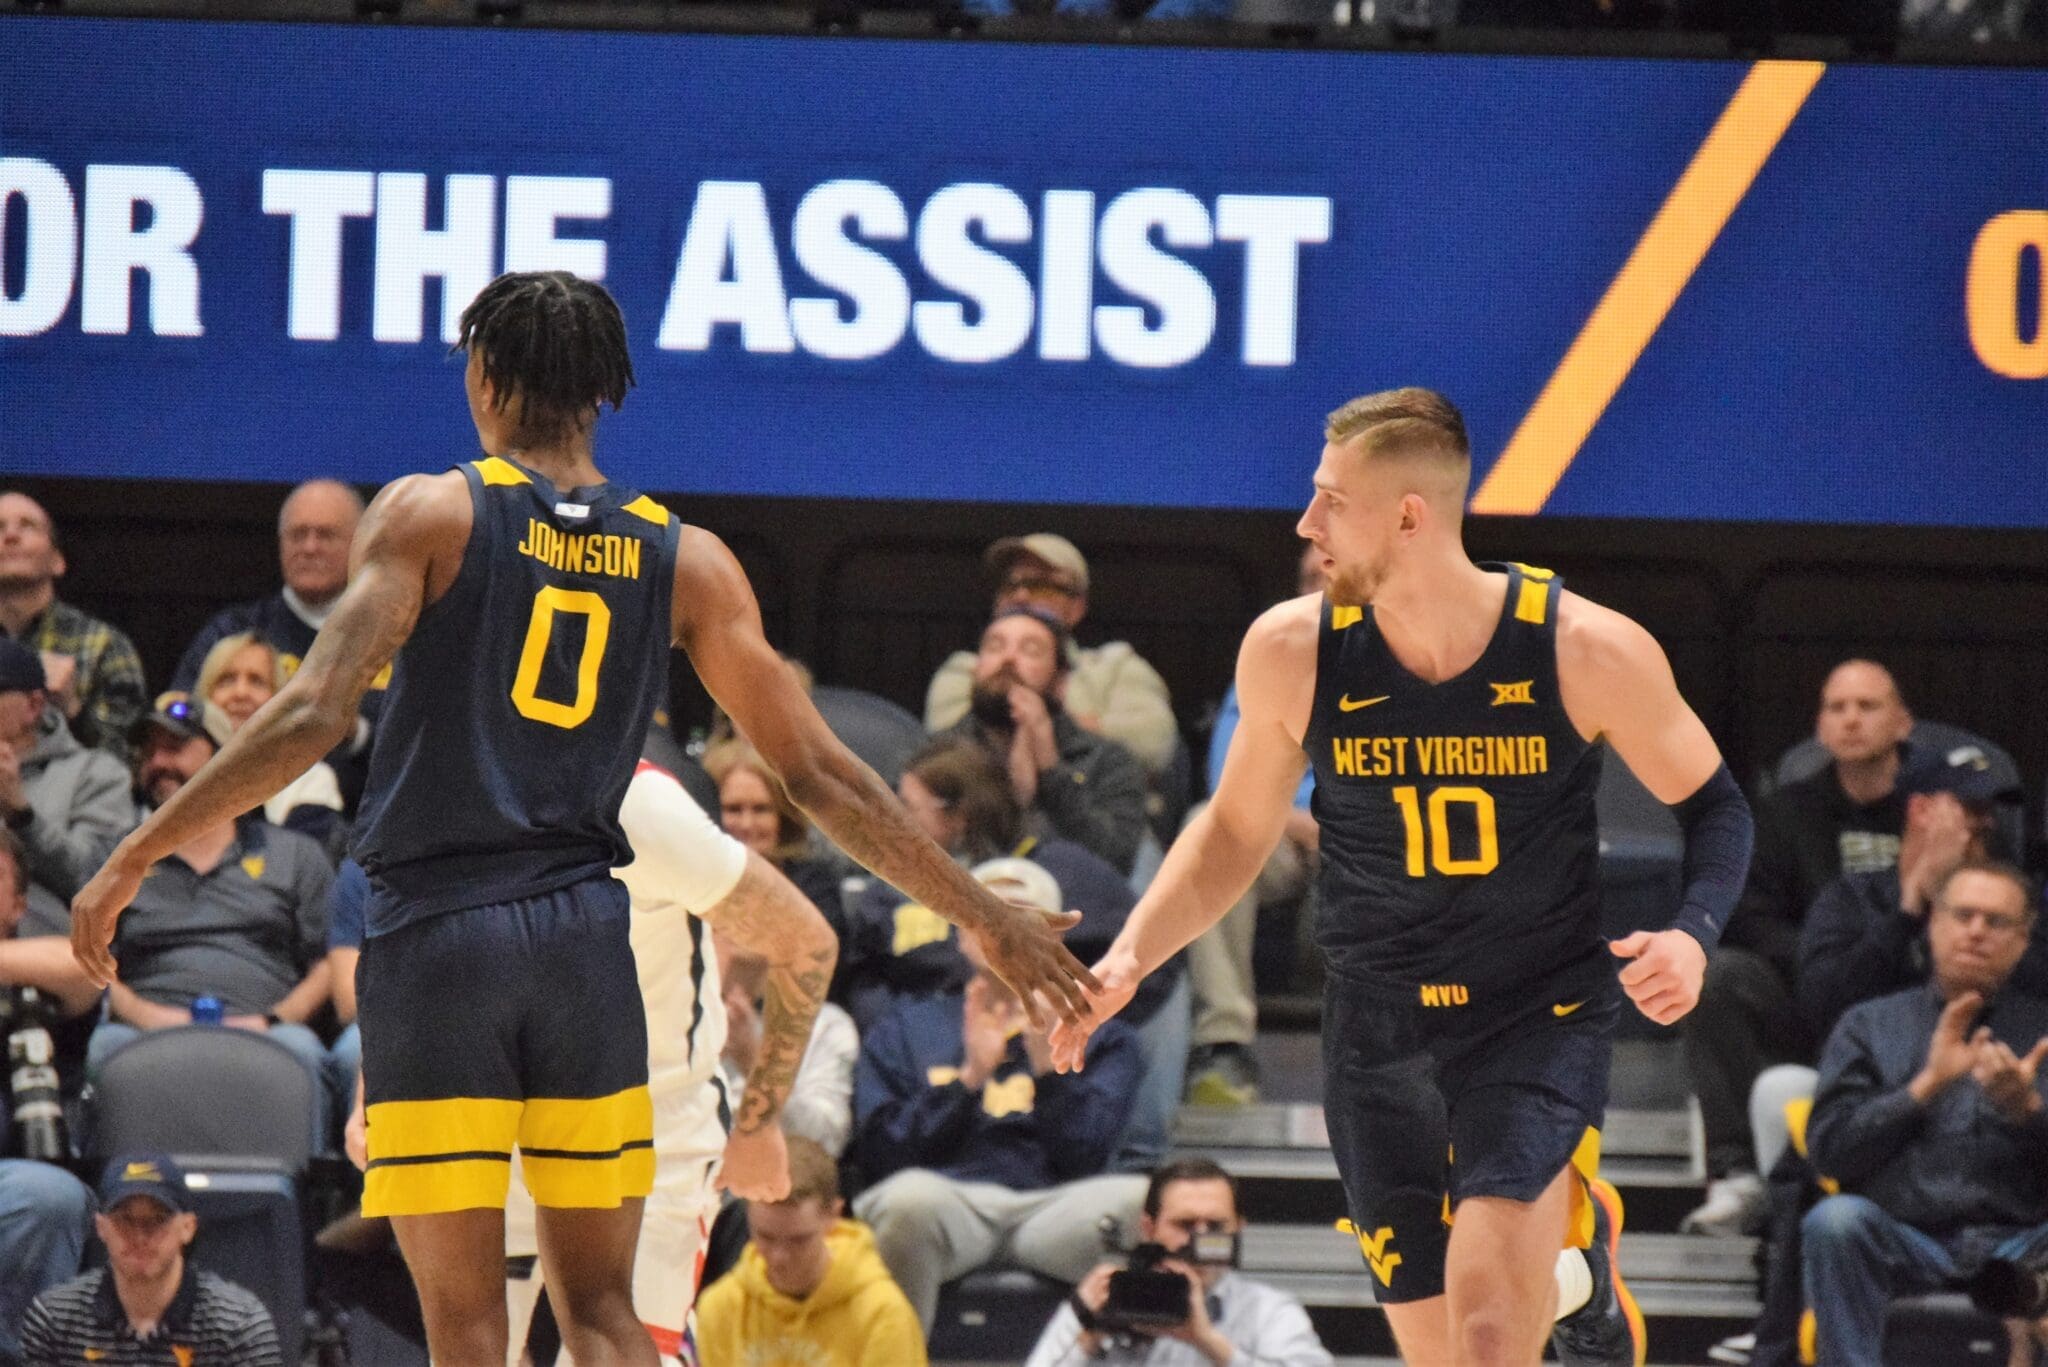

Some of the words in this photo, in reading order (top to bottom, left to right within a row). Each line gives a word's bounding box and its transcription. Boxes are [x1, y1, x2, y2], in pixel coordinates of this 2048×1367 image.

[262, 168, 612, 343] THE
[657, 179, 1332, 368] ASSIST
[518, 517, 641, 580] JOHNSON
[510, 584, 612, 730] 0
[1332, 737, 1409, 776] WEST
[1415, 735, 1548, 776] VIRGINIA
[1392, 785, 1499, 878] 10
[1420, 984, 1469, 1007] WVU
